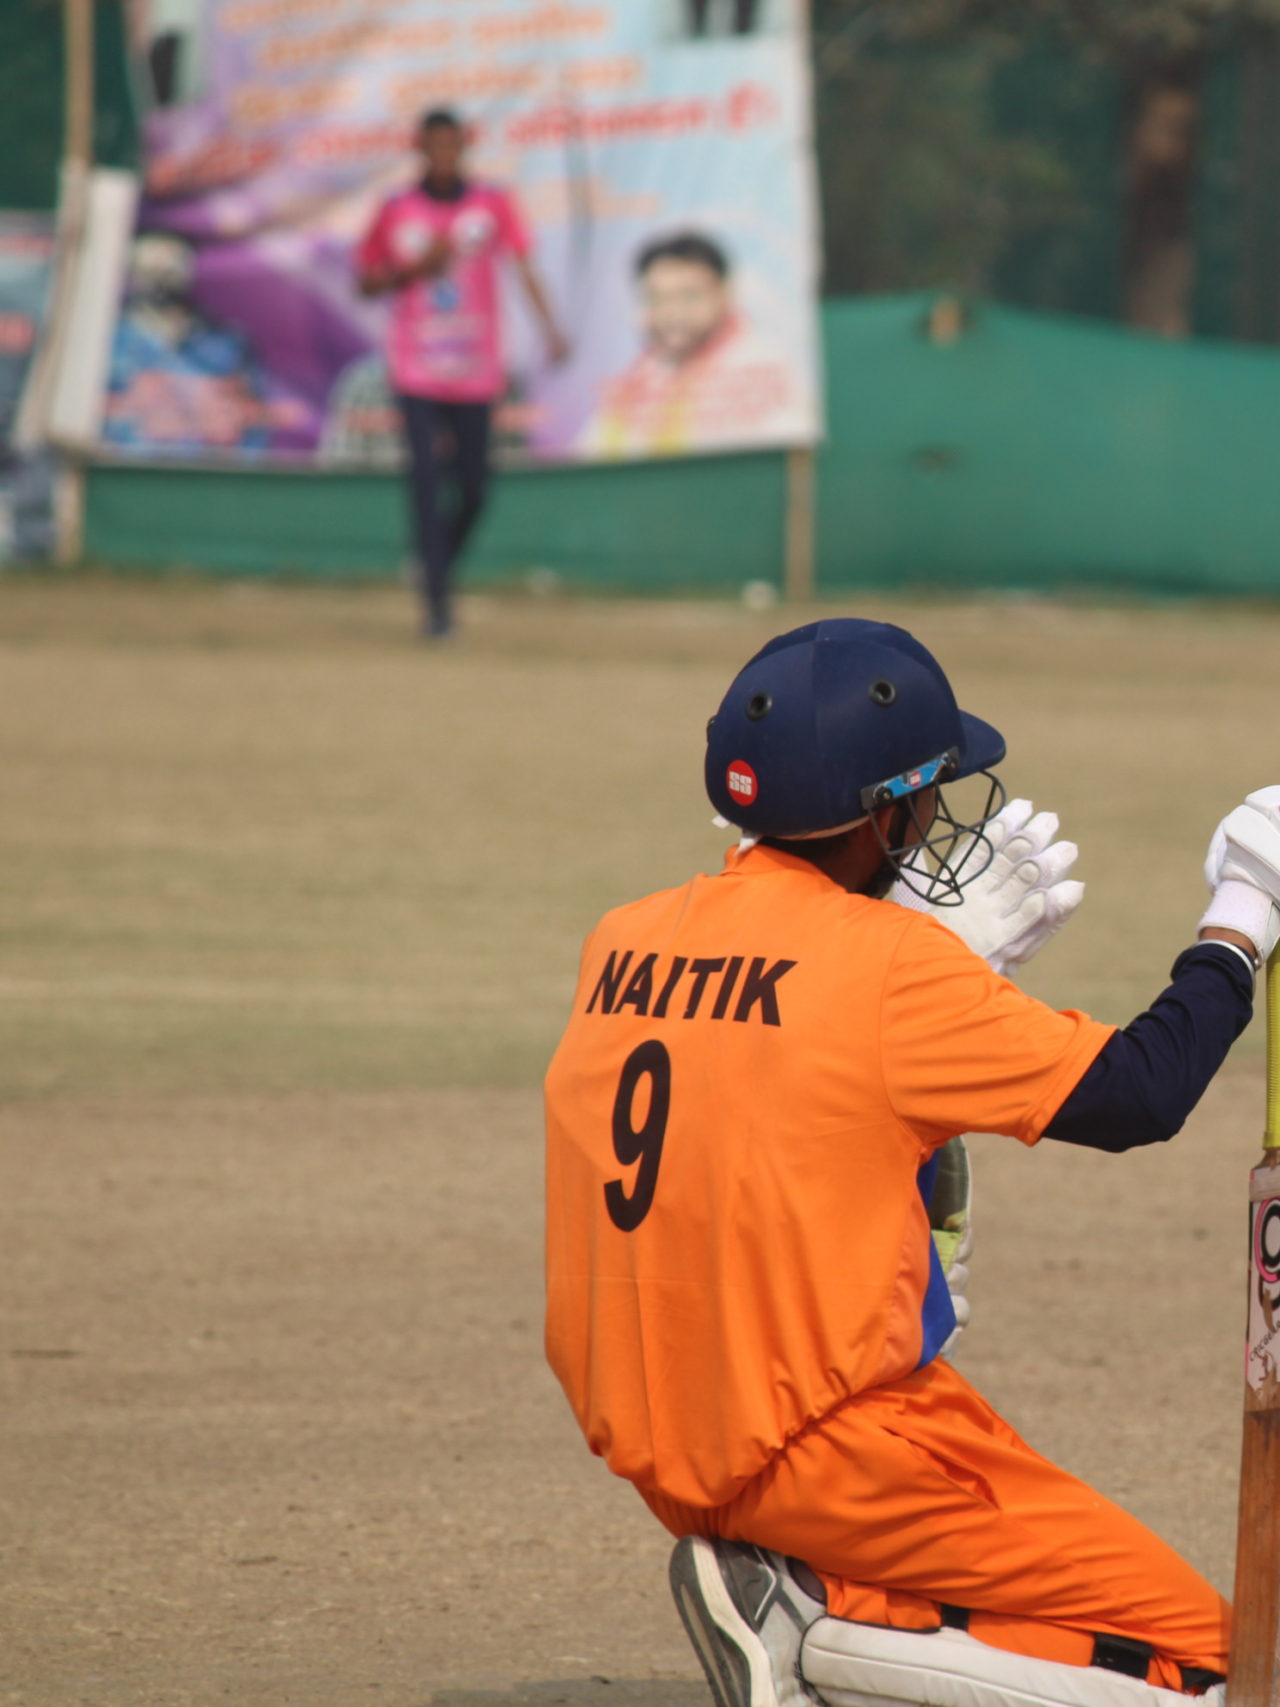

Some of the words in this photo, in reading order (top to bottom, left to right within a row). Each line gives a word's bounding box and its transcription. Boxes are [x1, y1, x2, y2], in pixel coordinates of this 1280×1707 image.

[728, 771, 752, 795] SS
[585, 949, 799, 1027] NAITIK
[603, 1039, 671, 1232] 9
